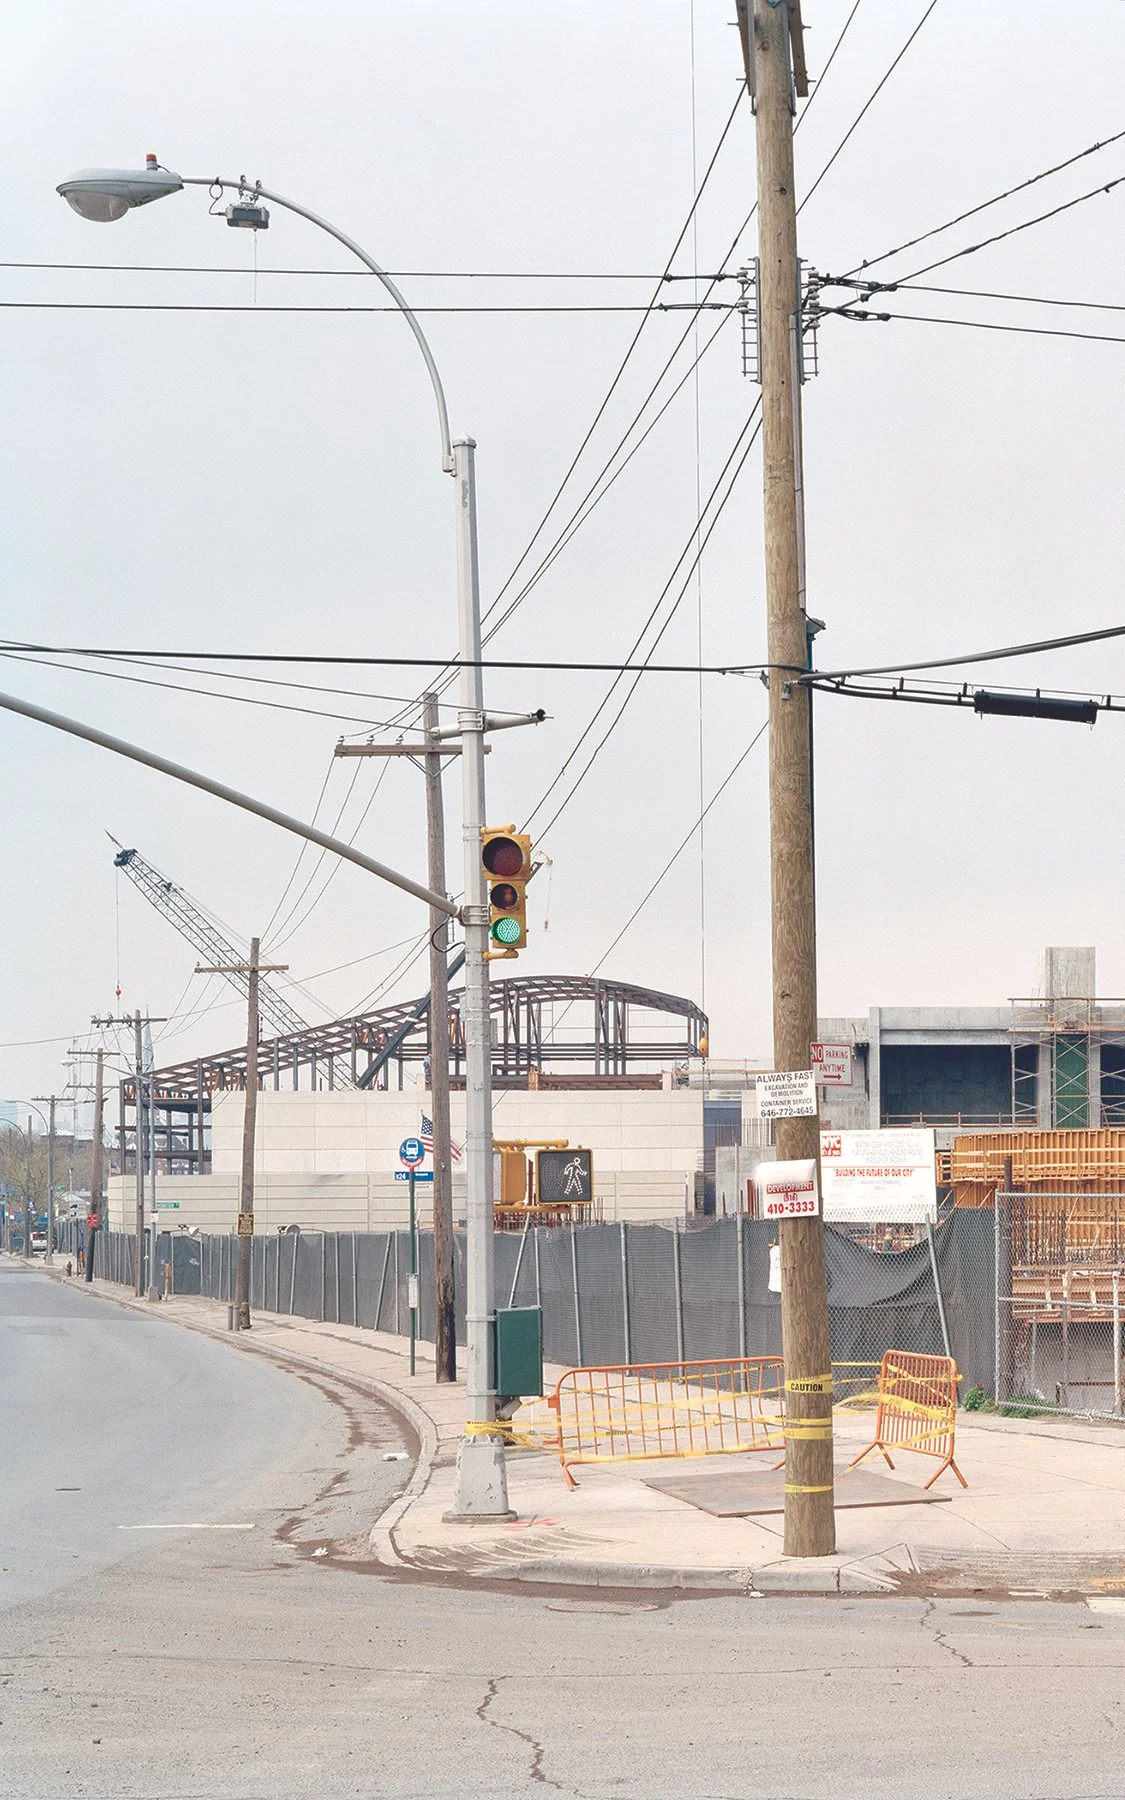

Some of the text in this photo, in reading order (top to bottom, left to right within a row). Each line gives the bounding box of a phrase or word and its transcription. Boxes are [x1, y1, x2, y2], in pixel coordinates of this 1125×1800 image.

[812, 1046, 849, 1060] NO PARKING
[819, 1064, 845, 1072] ANYTIME
[757, 1071, 814, 1083] ALWAYS FAST
[764, 1082, 797, 1091] EXCAVATION
[760, 1099, 792, 1107] CONTAINER
[760, 1107, 814, 1117] 646-772-4645
[767, 1182, 813, 1192] DEVELOPMENT
[767, 1201, 815, 1214] 410-3333
[790, 1383, 823, 1391] CAUTION
